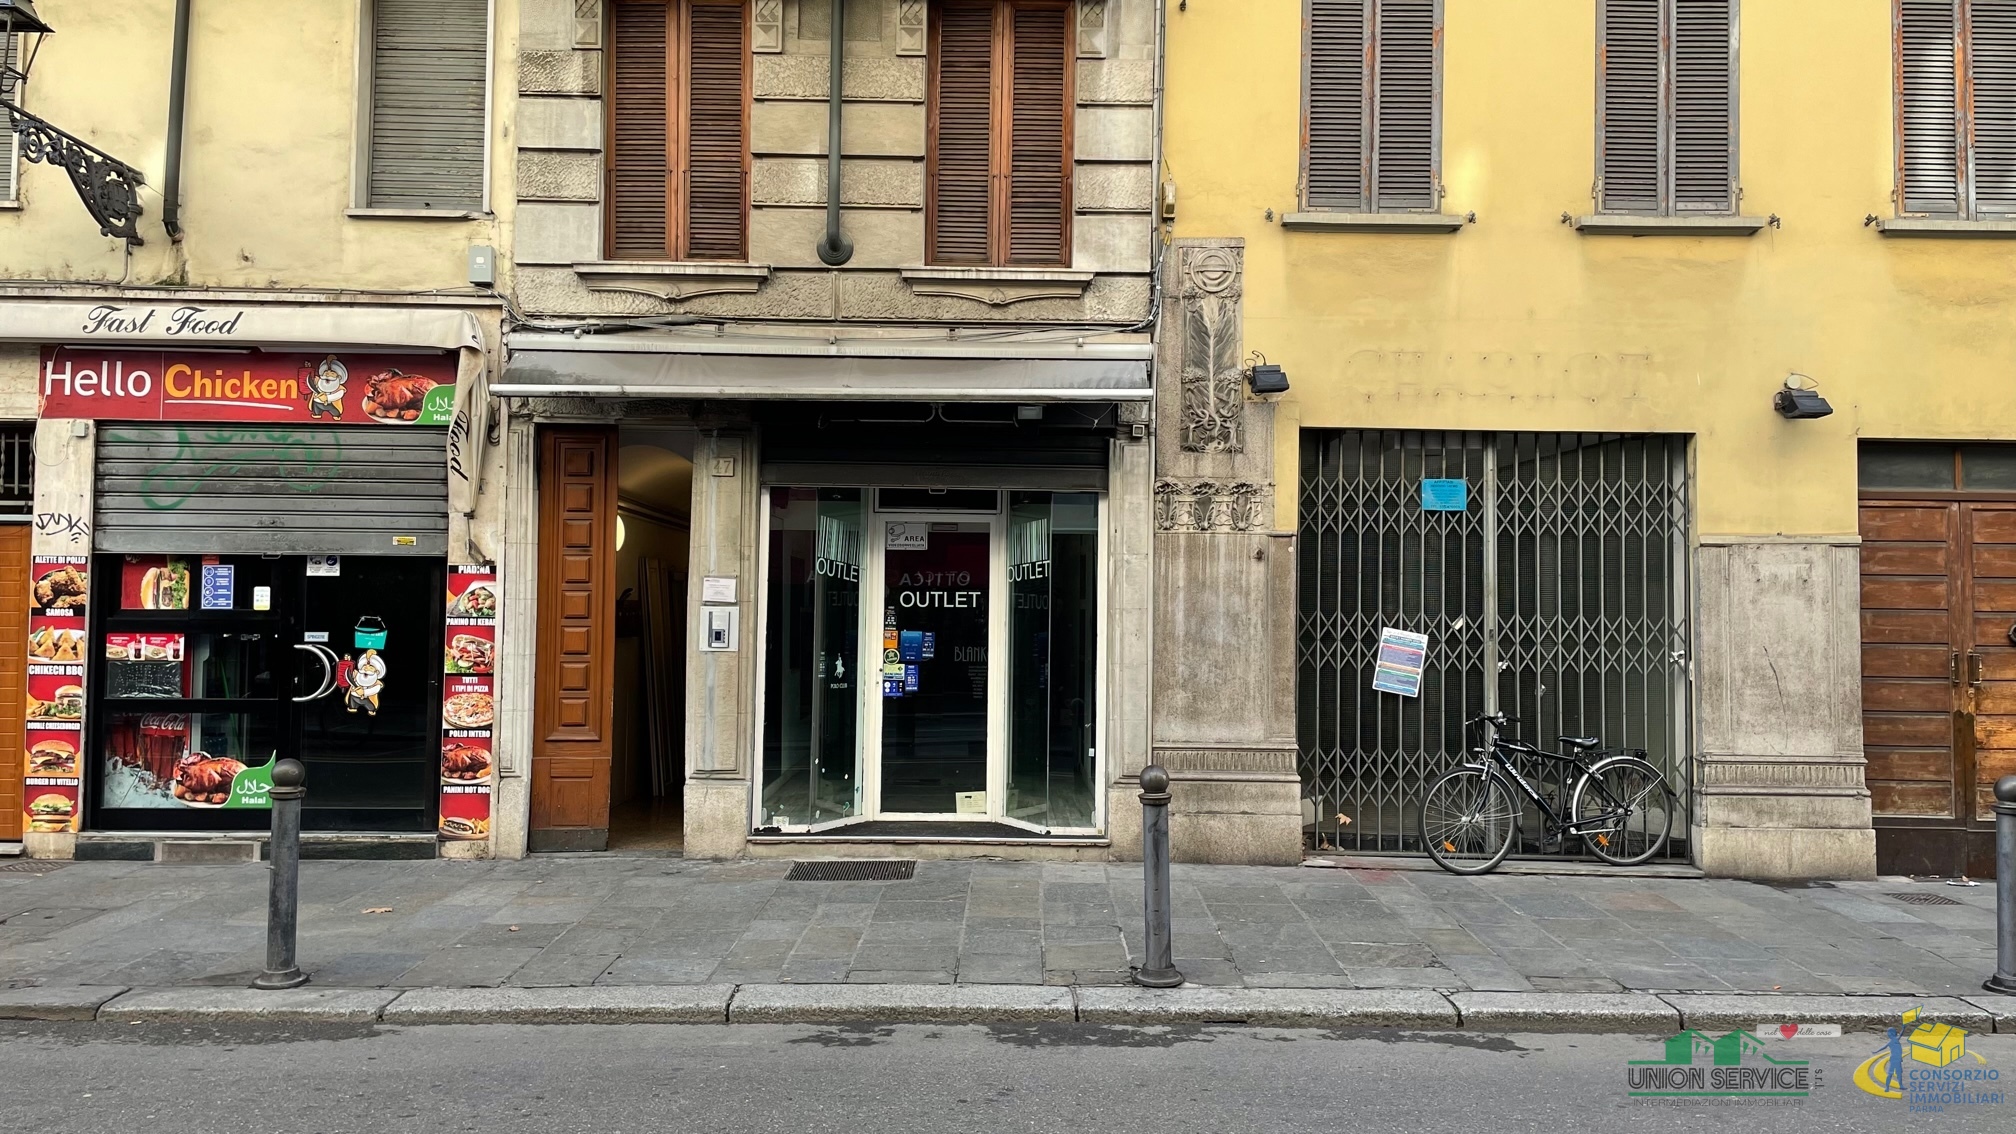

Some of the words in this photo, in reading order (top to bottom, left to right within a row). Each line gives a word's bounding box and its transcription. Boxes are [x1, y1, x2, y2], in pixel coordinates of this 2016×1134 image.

[82, 304, 156, 334] Fast
[166, 306, 244, 336] Food
[45, 360, 152, 398] Hello
[164, 363, 299, 400] Chicken
[713, 460, 732, 475] 47
[35, 556, 57, 564] ALETTE
[58, 556, 66, 564] DI
[66, 556, 86, 564] POLLO
[458, 565, 490, 574] PIADINA
[1007, 560, 1050, 582] OUTLET
[900, 590, 982, 608] OUTLET
[45, 608, 74, 617] SAMOSA
[446, 617, 470, 626] PANINO
[470, 617, 477, 626] DI
[65, 666, 83, 677] BBQ
[462, 676, 478, 684] TUTTI
[449, 730, 468, 738] POLLO
[468, 730, 491, 738] INTERO
[26, 777, 49, 785] BURGER
[49, 777, 57, 785] DI
[57, 778, 78, 786] VITELLO
[236, 779, 273, 794] حلال
[443, 786, 464, 794] PANINI
[464, 786, 478, 794] HOT
[477, 786, 491, 794] DOG
[241, 796, 266, 804] Halal
